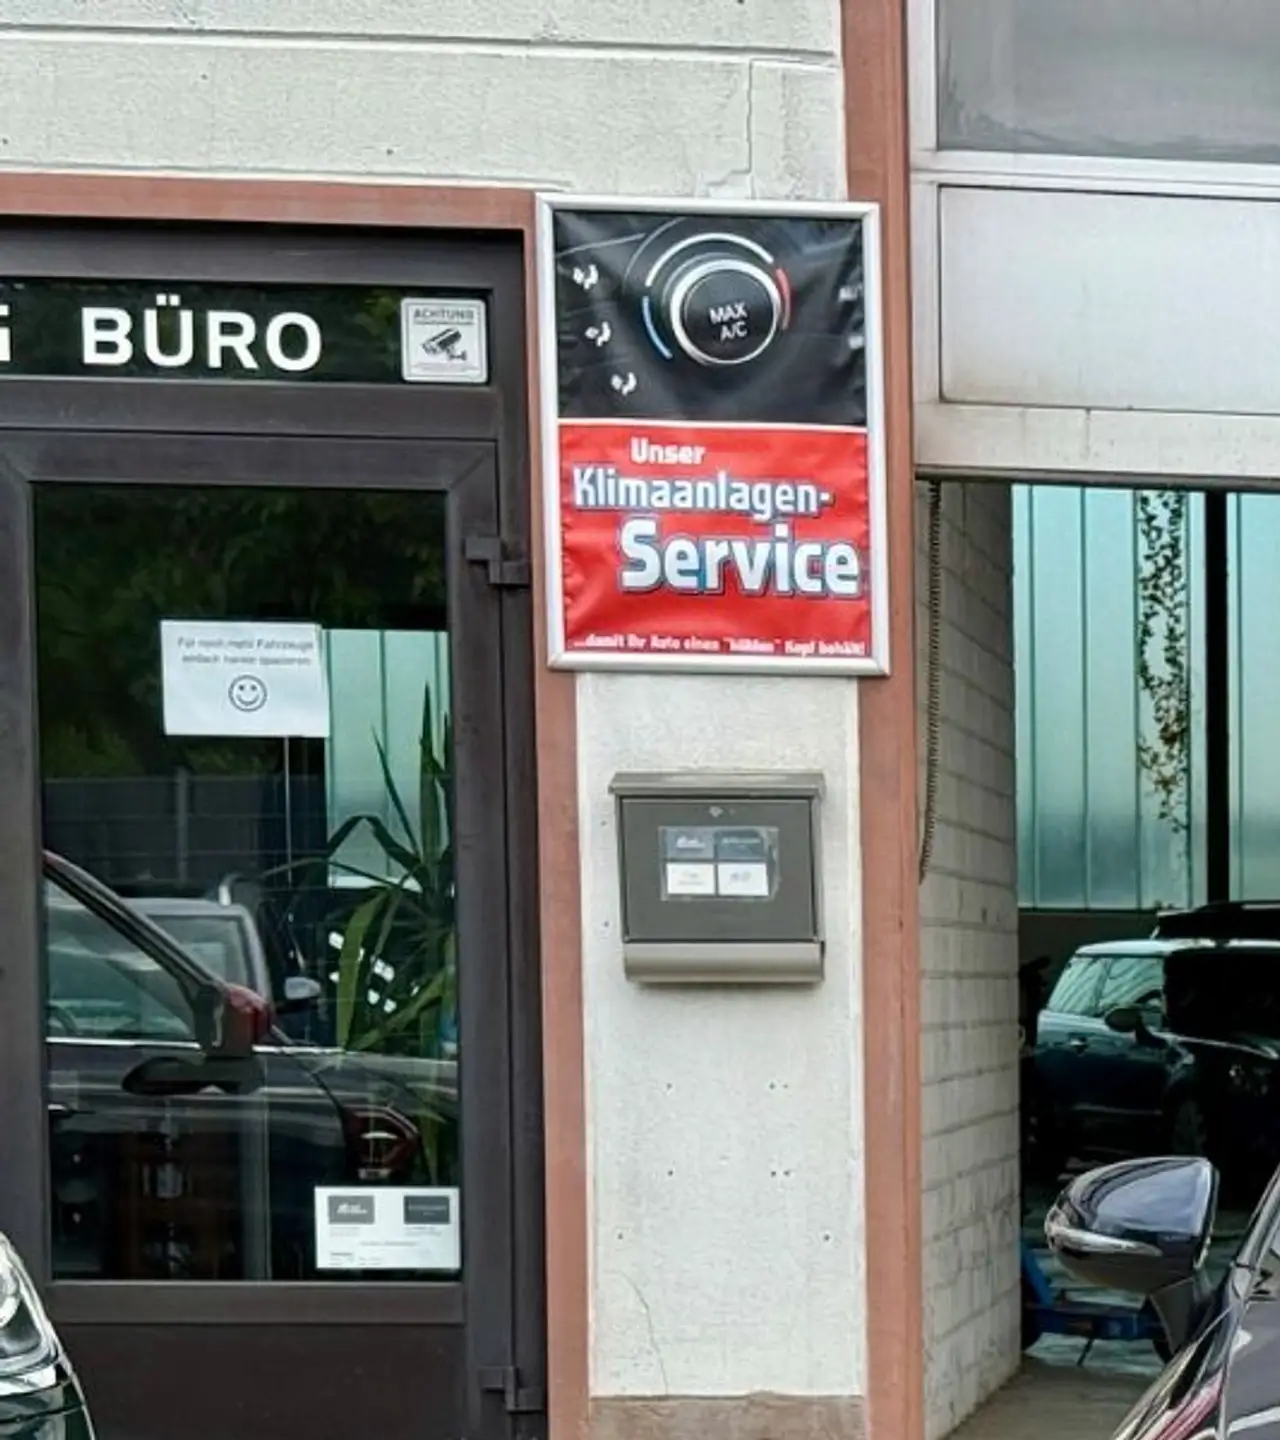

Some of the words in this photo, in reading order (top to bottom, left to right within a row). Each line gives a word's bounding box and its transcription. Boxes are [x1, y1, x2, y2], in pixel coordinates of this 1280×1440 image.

[81, 293, 322, 371] BÜRO
[709, 301, 748, 324] MAX
[720, 320, 748, 341] A/C
[631, 437, 705, 464] Unser
[572, 465, 833, 521] Klimaanlagen-
[619, 518, 861, 596] Service
